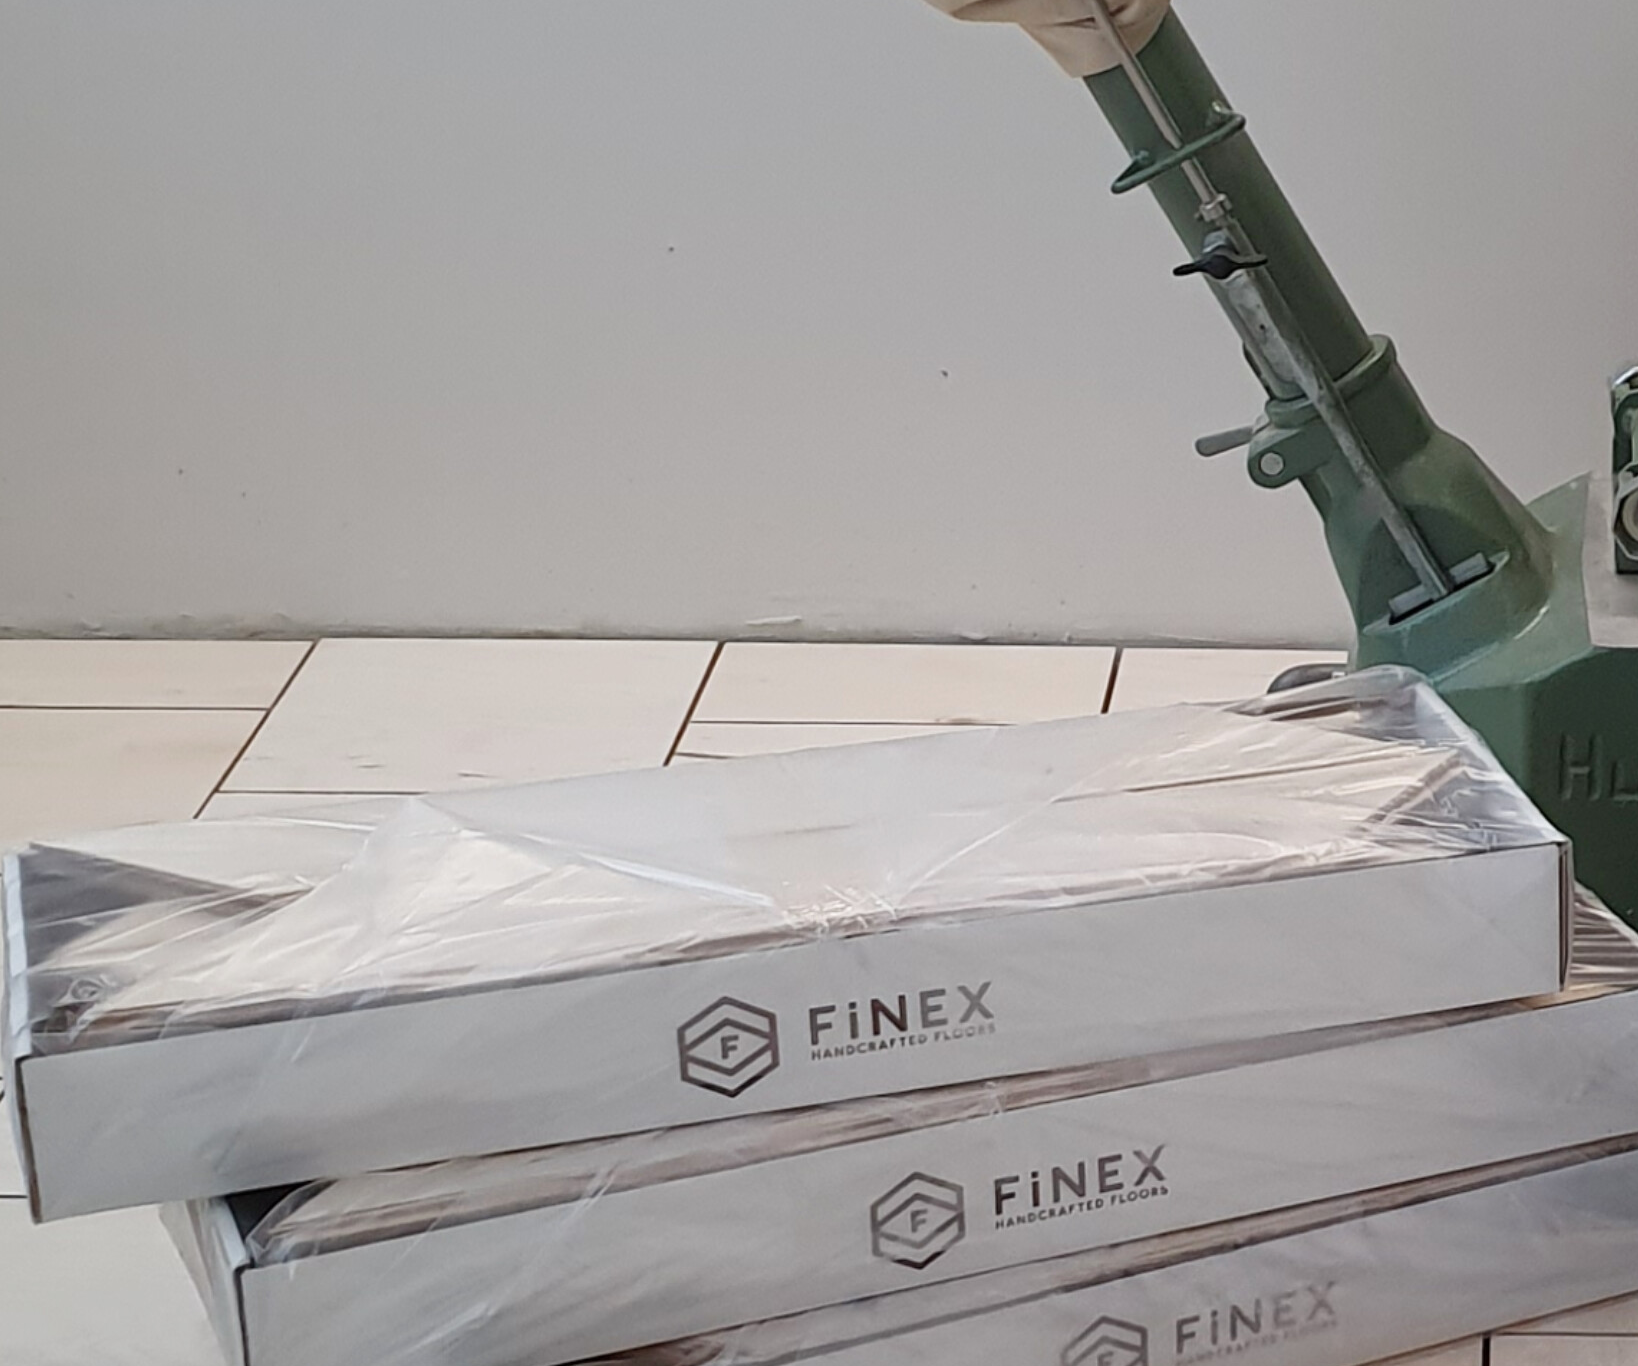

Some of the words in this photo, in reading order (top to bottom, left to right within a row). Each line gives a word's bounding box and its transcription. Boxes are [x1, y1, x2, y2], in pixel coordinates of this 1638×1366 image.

[720, 1034, 740, 1060] F
[811, 1033, 928, 1062] HANDCRAFTED
[934, 1022, 996, 1043] FLOORS
[910, 1208, 928, 1233] F
[995, 1198, 1105, 1230] HANDCRAFTED
[1110, 1185, 1169, 1207] FLOORS
